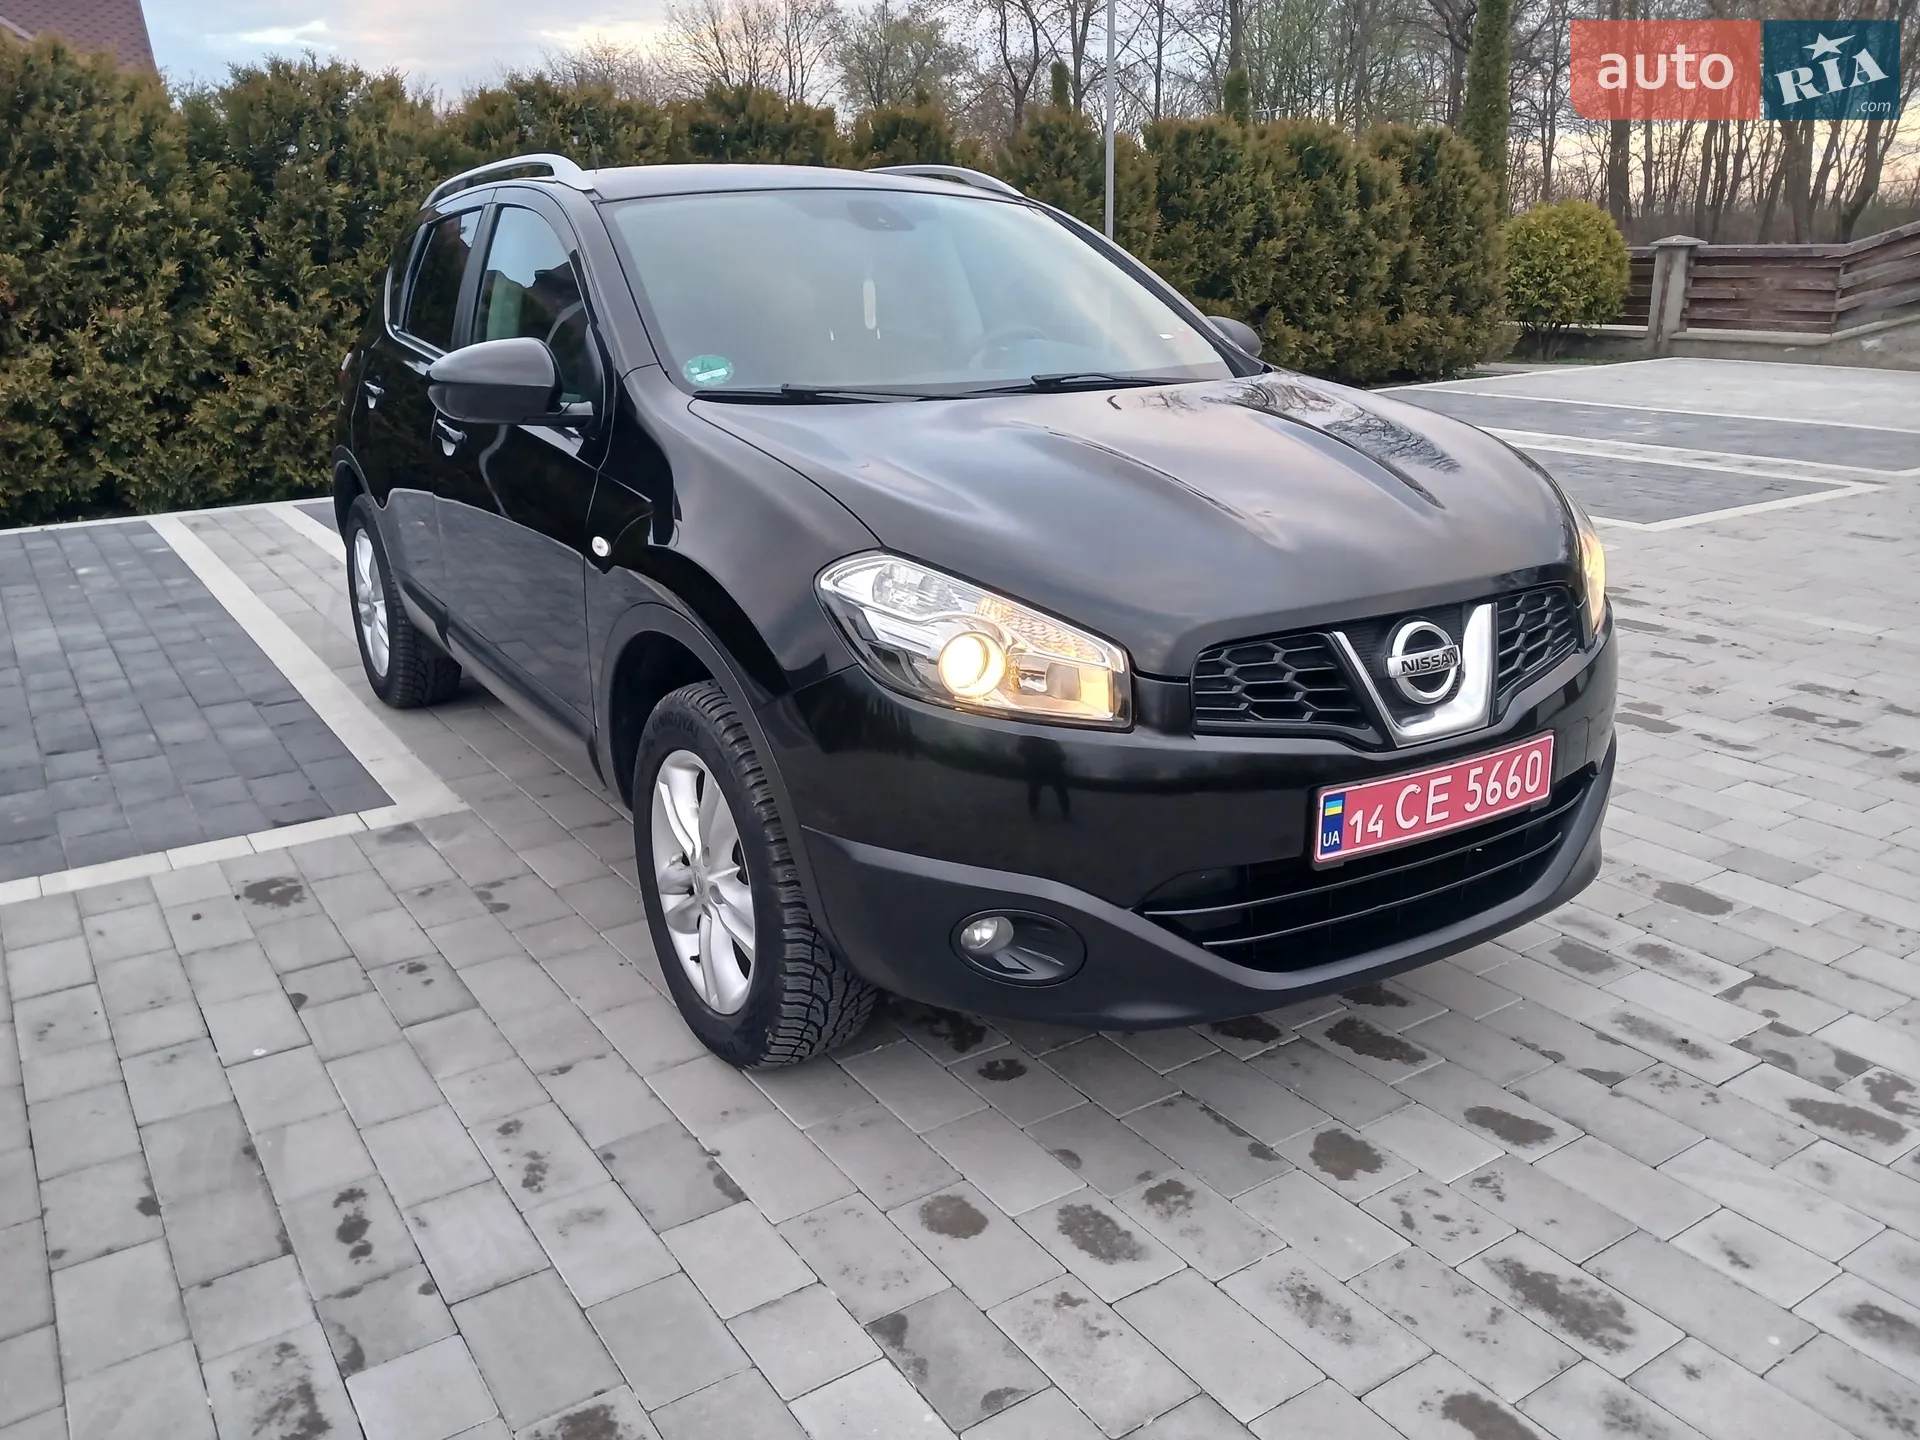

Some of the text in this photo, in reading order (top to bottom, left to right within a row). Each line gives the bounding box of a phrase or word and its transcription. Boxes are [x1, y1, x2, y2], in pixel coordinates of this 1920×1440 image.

[1401, 651, 1458, 673] NISSAN
[1348, 749, 1543, 844] 14 CE 5660
[1323, 831, 1340, 848] UA
